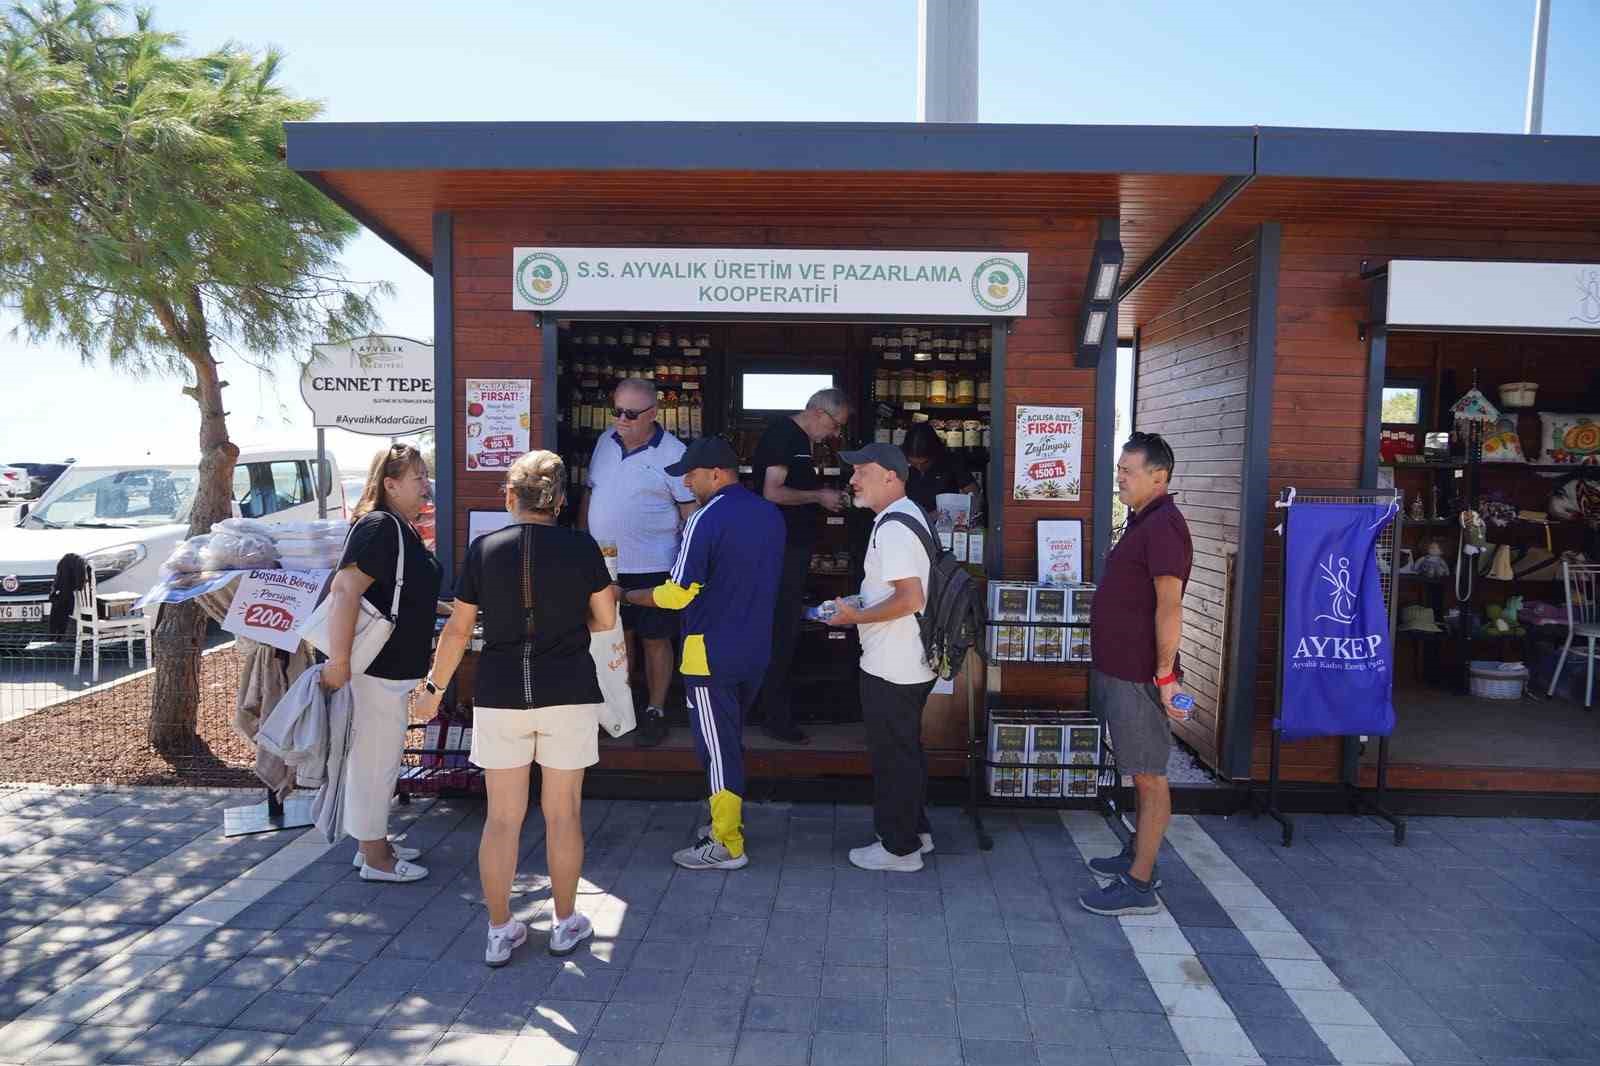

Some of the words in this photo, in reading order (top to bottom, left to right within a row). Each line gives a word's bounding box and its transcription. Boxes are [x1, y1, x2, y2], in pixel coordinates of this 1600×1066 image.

[577, 261, 615, 278] S.S.
[620, 262, 707, 279] AYVALIK
[714, 259, 792, 280] ÜRETİM
[799, 263, 825, 280] VE
[832, 264, 962, 282] PAZARLAMA
[699, 284, 838, 303] KOOPERATİFİ
[312, 377, 382, 391] CENNET
[386, 378, 435, 392] TEPE
[481, 392, 519, 401] FIRSAT!
[1028, 422, 1073, 435] FIRSAT!
[1035, 468, 1055, 478] 1500
[1055, 466, 1065, 476] TL
[249, 569, 288, 584] Boşnak
[22, 606, 41, 617] 610
[1292, 634, 1382, 660] AYKEP
